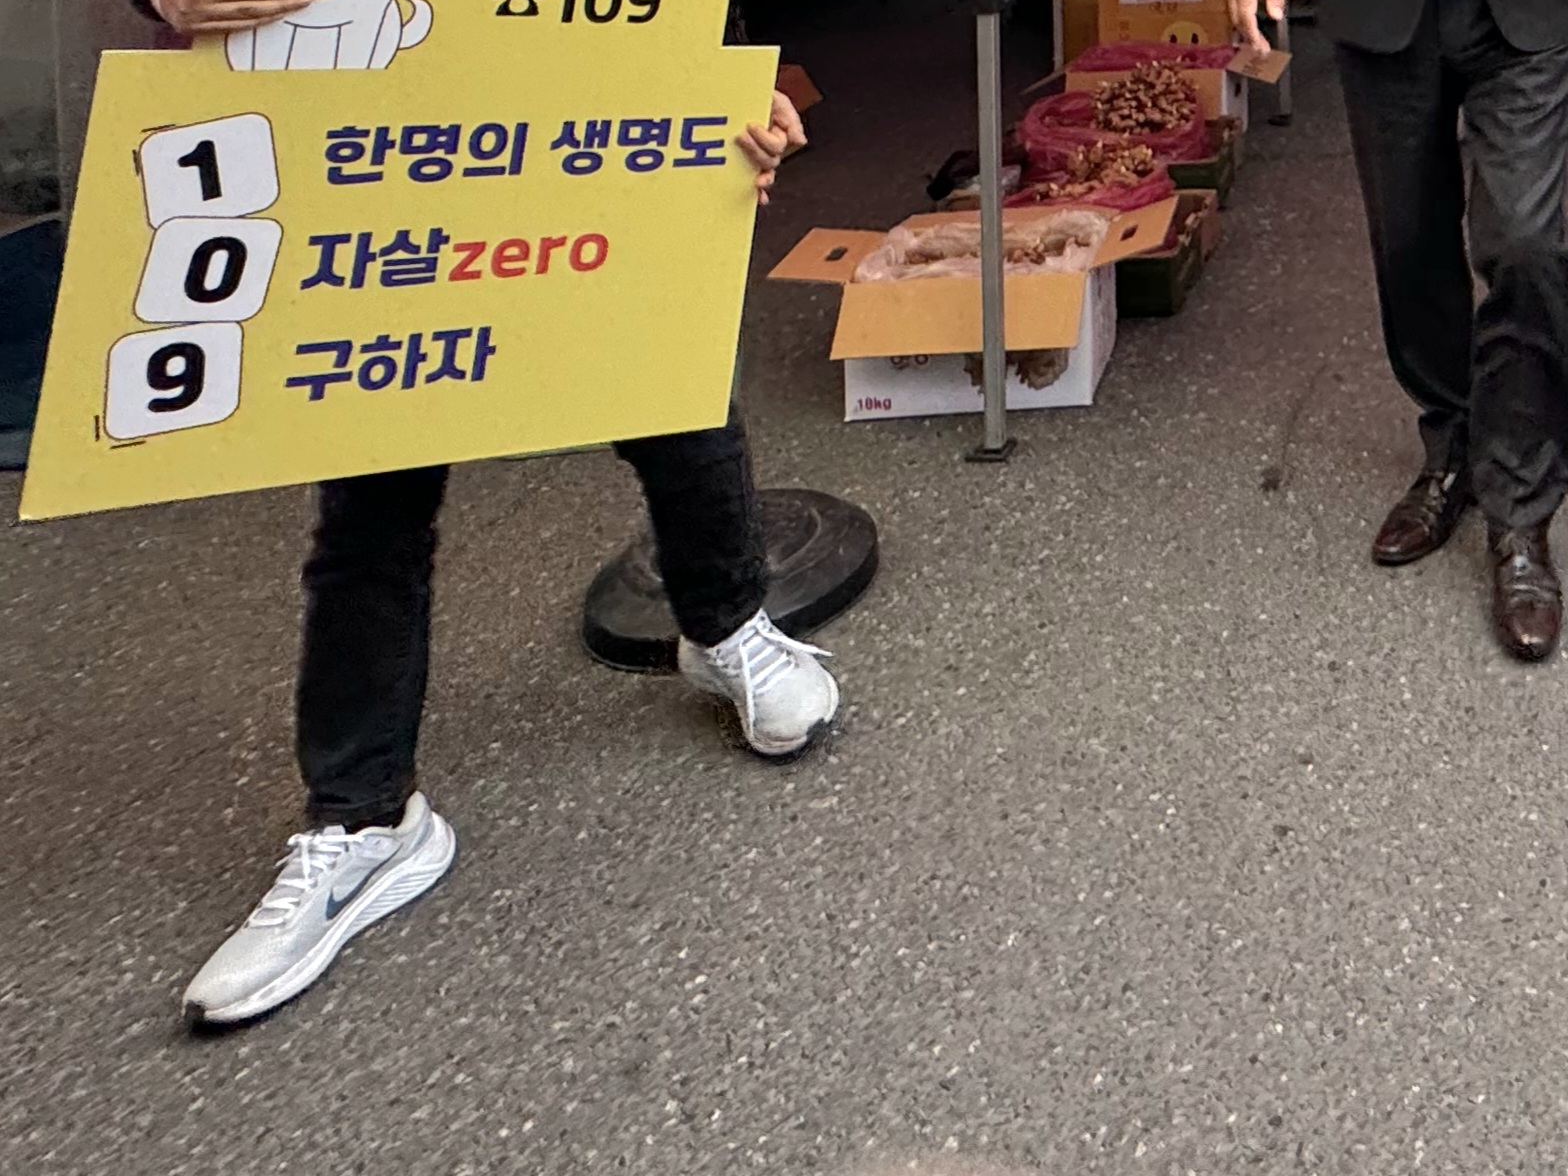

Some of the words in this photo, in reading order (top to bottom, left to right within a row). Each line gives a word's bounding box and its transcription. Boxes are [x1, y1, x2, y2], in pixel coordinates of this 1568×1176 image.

[177, 140, 222, 201] 1
[325, 122, 529, 185] 한명의
[550, 116, 729, 173] 생명도
[184, 236, 247, 303] 0
[300, 227, 609, 291] 자살zero
[147, 342, 206, 413] 9
[285, 326, 497, 401] 구하자
[858, 397, 892, 411] 10kg
